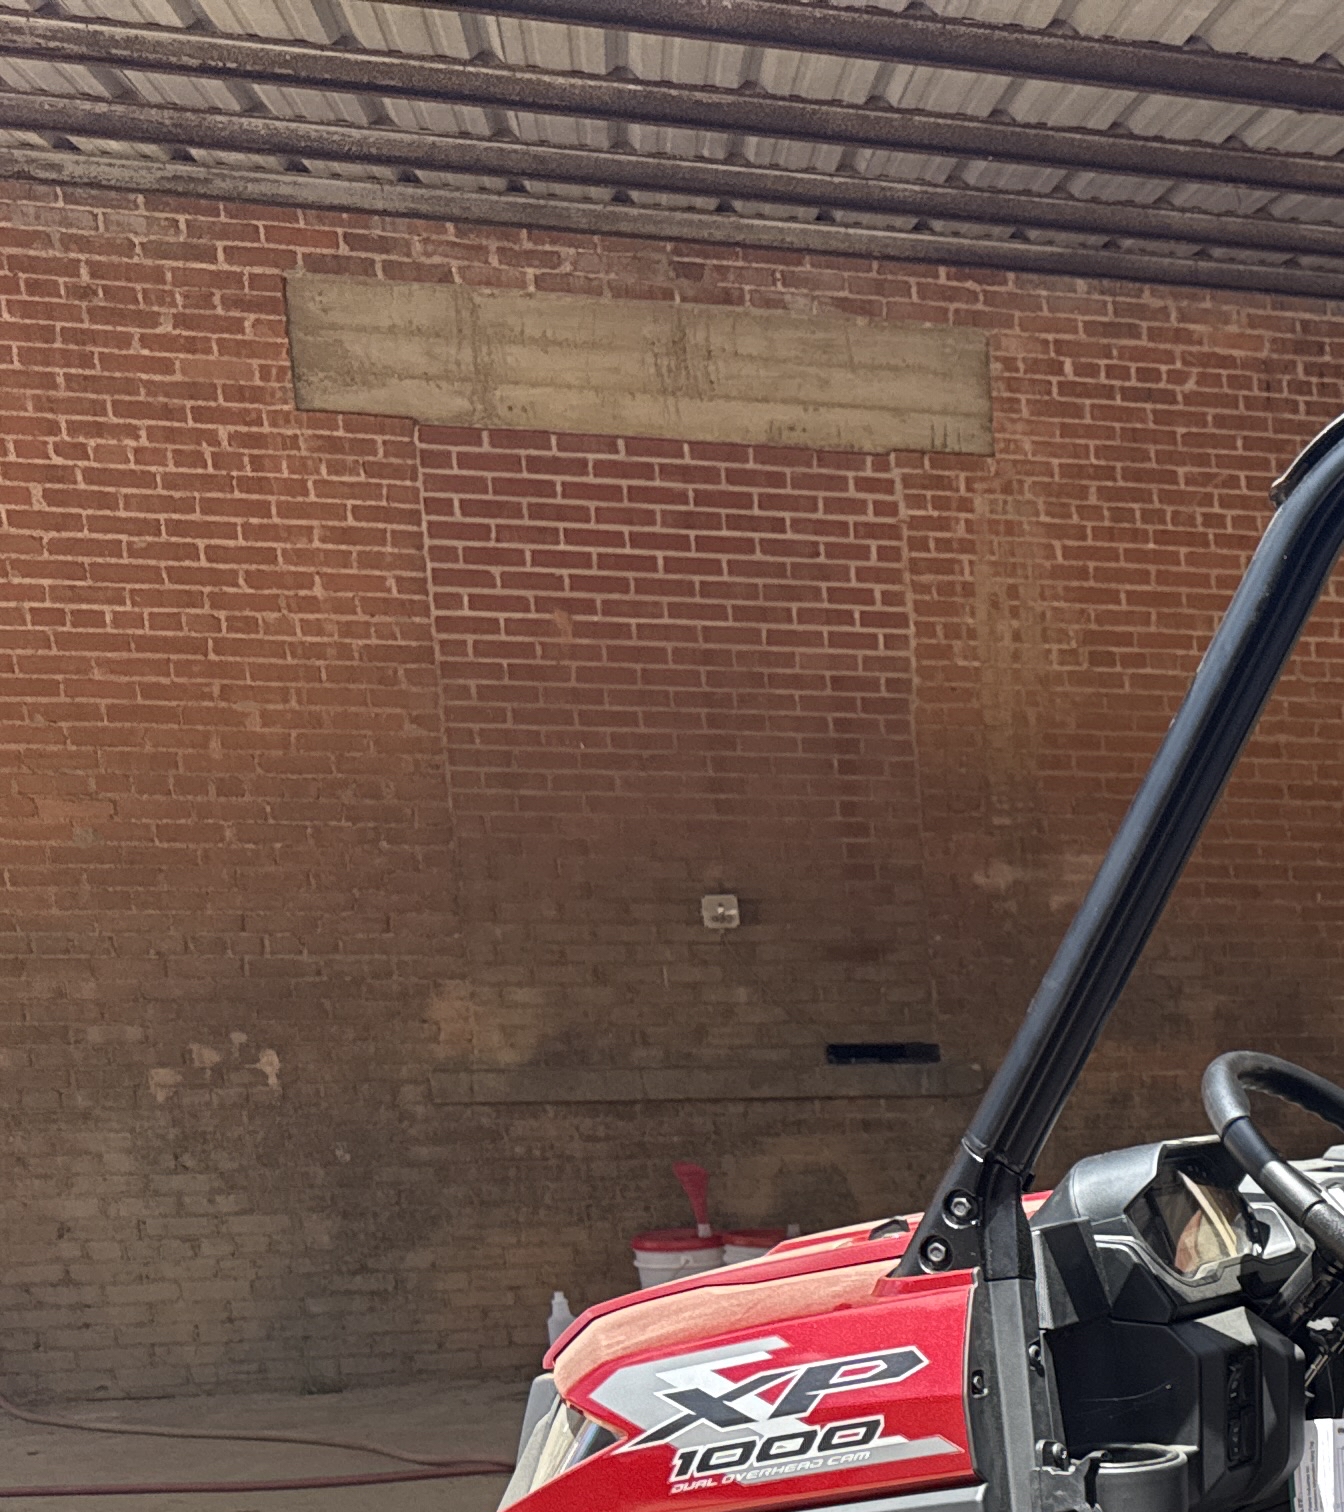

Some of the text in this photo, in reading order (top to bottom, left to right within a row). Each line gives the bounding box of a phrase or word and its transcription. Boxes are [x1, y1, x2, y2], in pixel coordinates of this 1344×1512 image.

[611, 1346, 929, 1455] XP
[668, 1414, 885, 1484] 1000
[671, 1450, 871, 1494] DUAL OVERHEAD CAM
